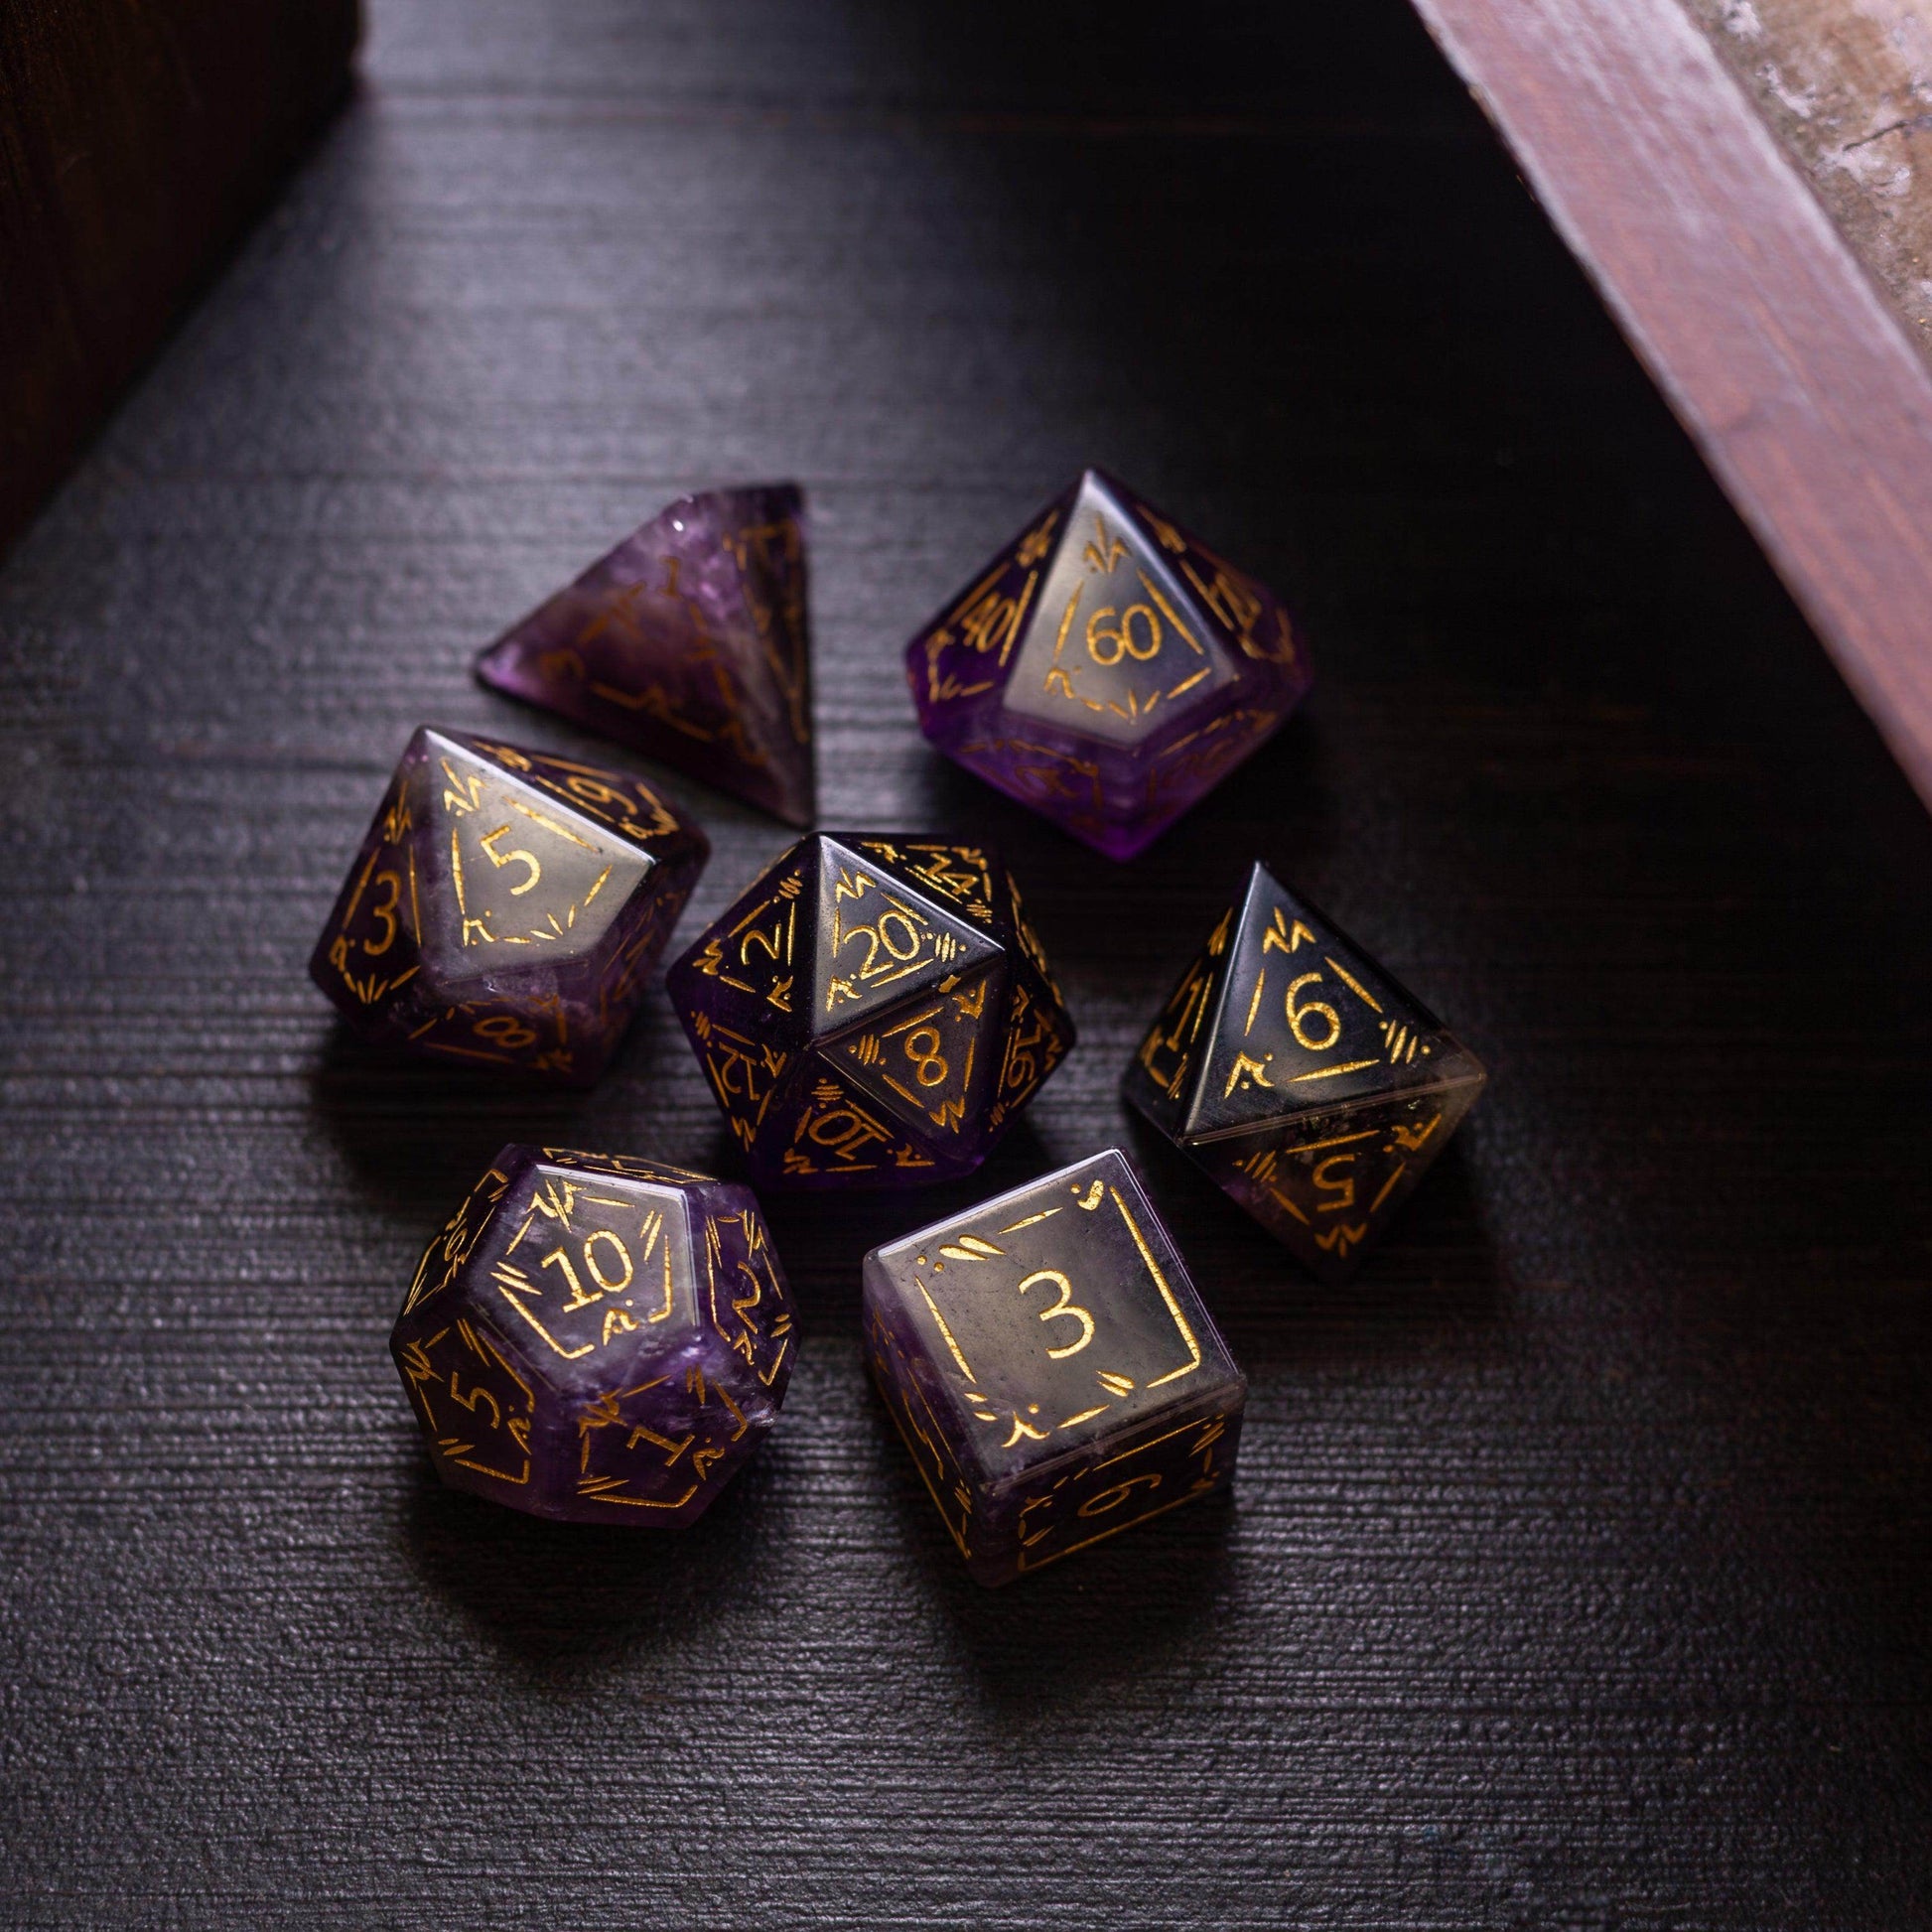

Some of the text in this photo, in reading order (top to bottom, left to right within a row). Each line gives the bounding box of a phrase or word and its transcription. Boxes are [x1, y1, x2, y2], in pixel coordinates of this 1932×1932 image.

[961, 592, 1019, 653] 40
[1086, 603, 1163, 666] 60
[480, 824, 541, 896] 5
[912, 851, 980, 895] 14
[363, 869, 401, 955] 3
[740, 923, 782, 967] 2
[843, 911, 920, 981] 20
[472, 1016, 537, 1048] 8
[1285, 971, 1341, 1051] 6
[717, 1041, 760, 1102] 12
[903, 1025, 949, 1088] 8
[1007, 1023, 1042, 1089] 16
[807, 1108, 889, 1162] 10
[1311, 1153, 1356, 1213] 5
[540, 1228, 634, 1314] 10
[731, 1261, 762, 1335] 2
[1018, 1269, 1096, 1360] 3
[450, 1370, 501, 1430] 5
[625, 1424, 696, 1468] 1
